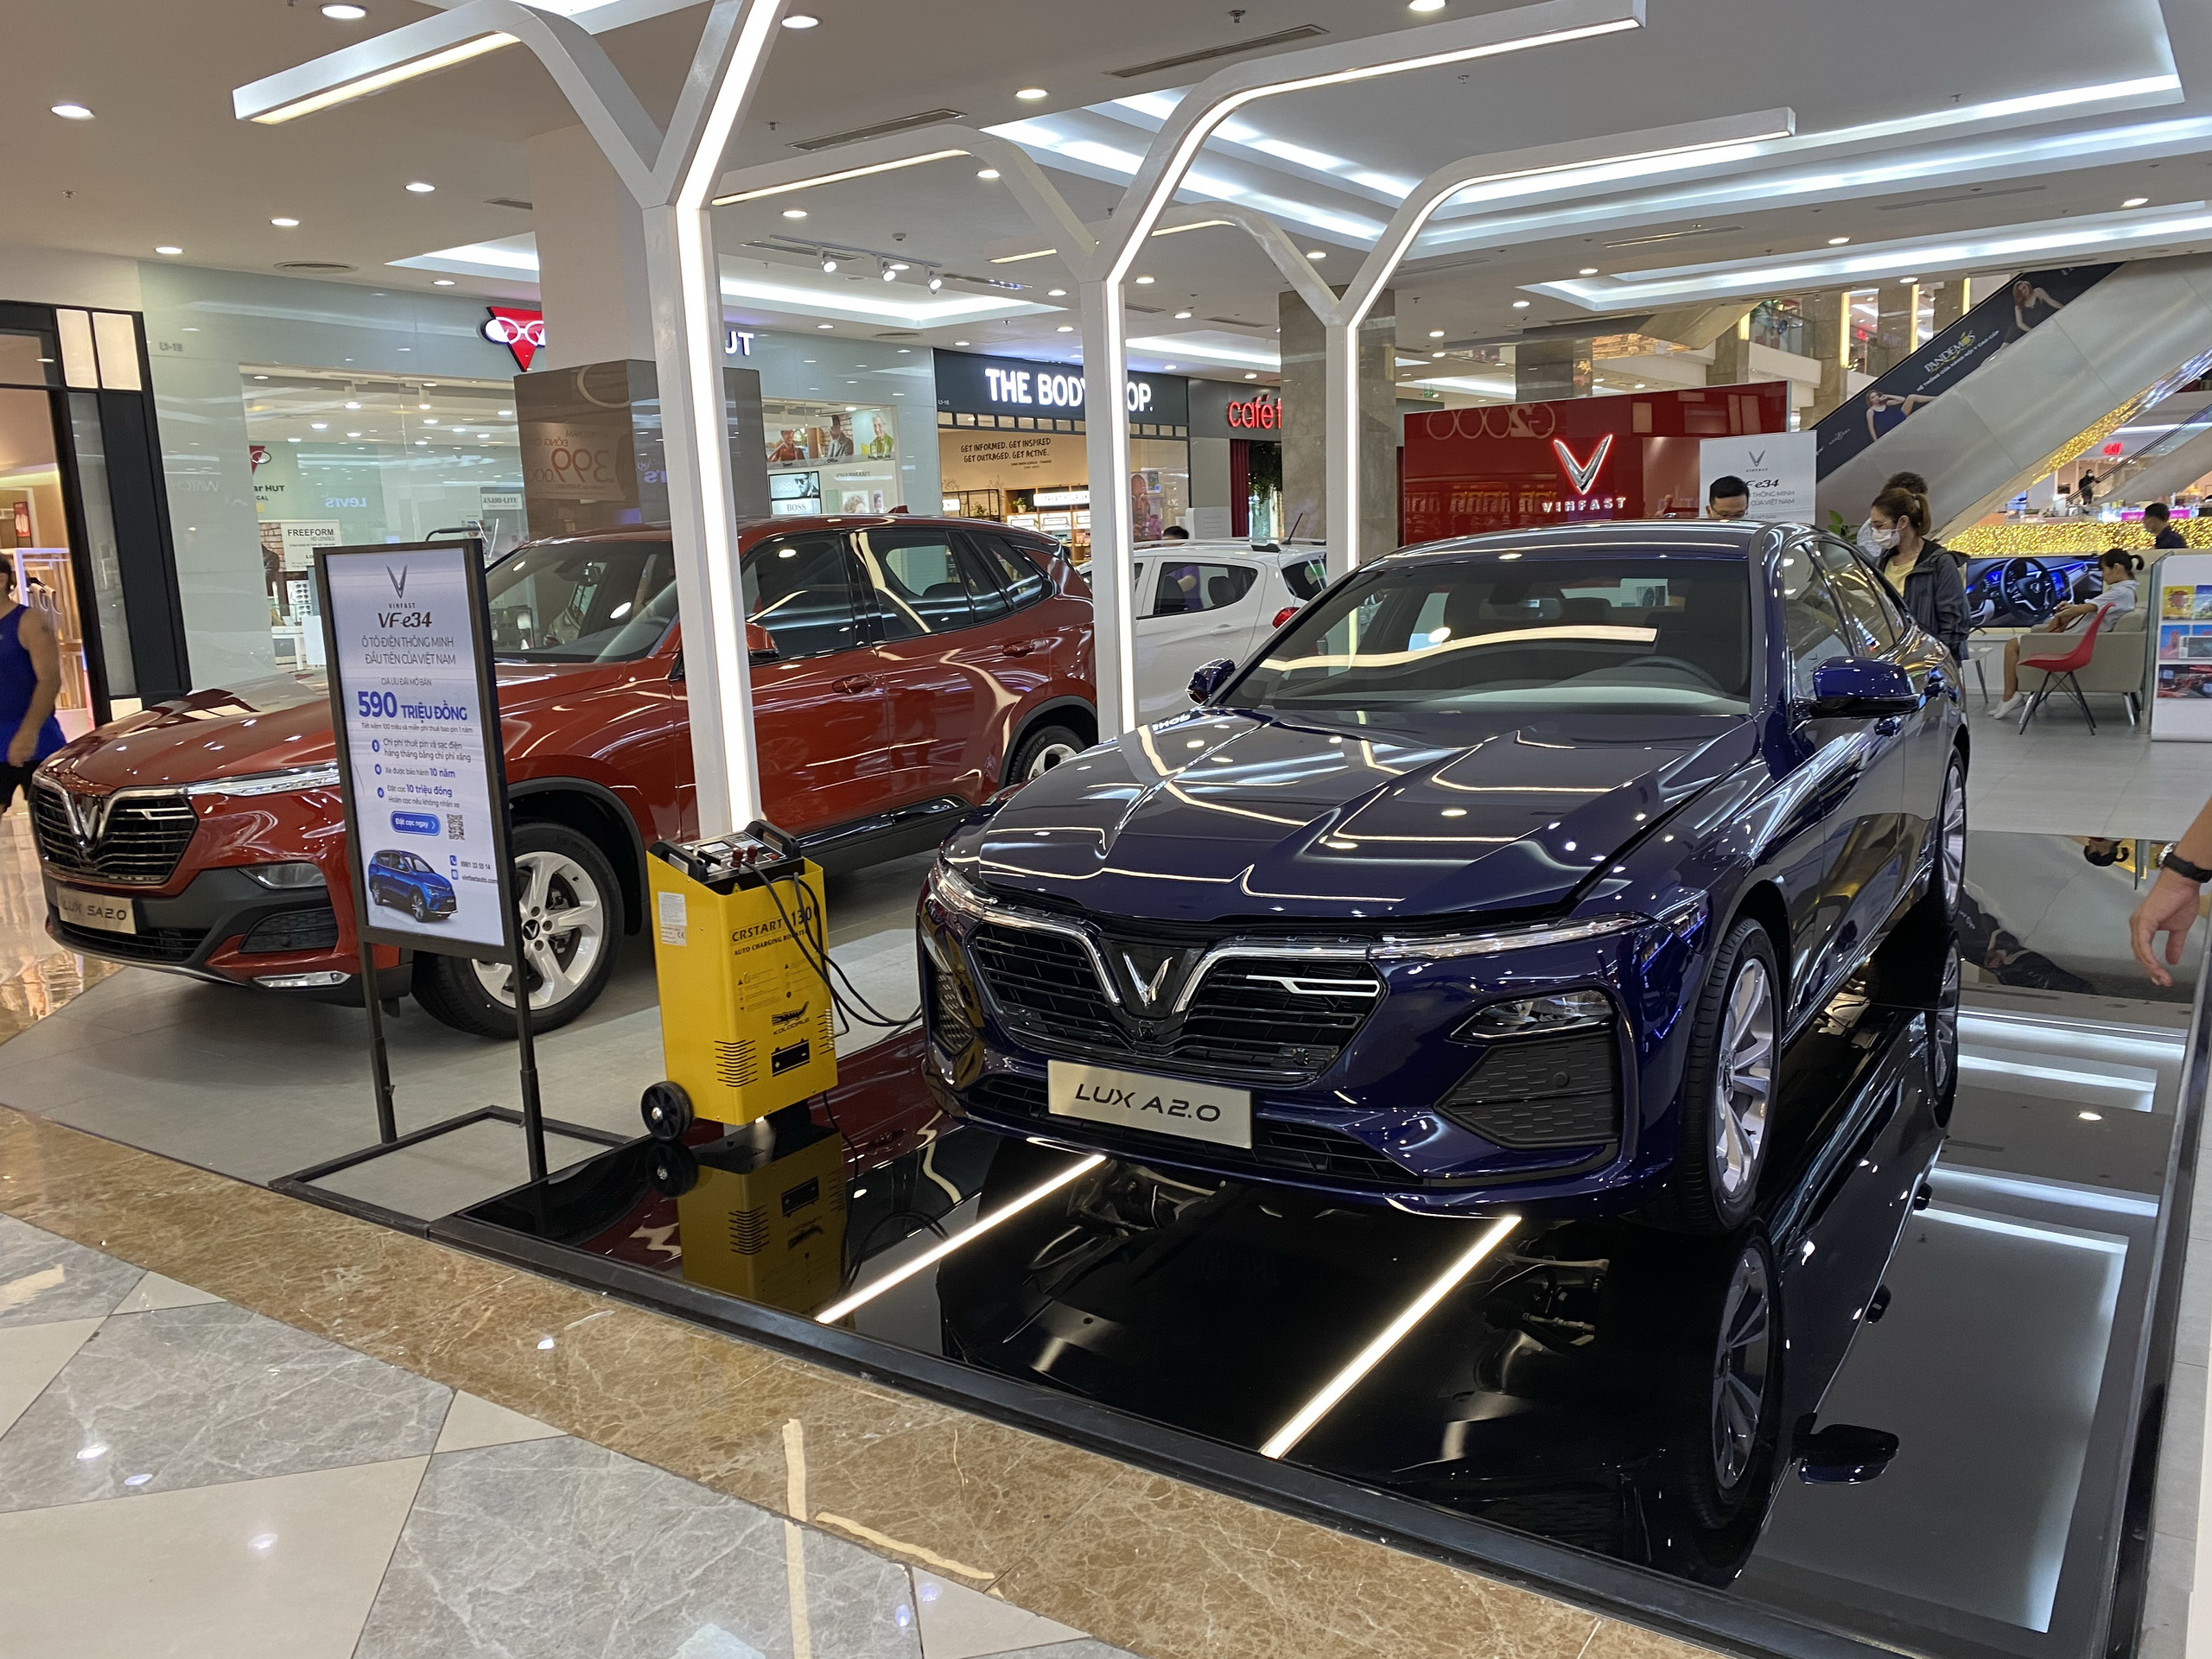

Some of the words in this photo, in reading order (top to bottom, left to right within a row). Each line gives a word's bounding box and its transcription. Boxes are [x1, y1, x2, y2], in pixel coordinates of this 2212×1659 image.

[724, 331, 754, 356] UT
[984, 368, 1033, 404] THE
[1228, 393, 1274, 429] café
[960, 444, 973, 453] GET
[974, 442, 1007, 452] INFORMED.
[1008, 440, 1021, 448] GET
[1022, 437, 1052, 448] INSPIRED
[963, 454, 976, 463] GET
[976, 452, 1011, 462] OUTRAGED.
[1012, 450, 1025, 459] GET
[1026, 448, 1050, 458] ACTIVE.
[786, 503, 806, 512] BOSS
[1541, 497, 1626, 513] VINFAST
[432, 637, 454, 647] MINH
[436, 654, 456, 664] NAM
[358, 691, 397, 718] 590
[400, 702, 433, 723] TRIỆU
[434, 700, 467, 721] ĐỒNG
[429, 767, 438, 777] 10
[406, 785, 414, 793] 10
[86, 905, 127, 921] SA2.0
[732, 918, 782, 942] CRSTART
[734, 946, 750, 956] AUTO
[752, 937, 782, 950] CHARGING
[1075, 1084, 1136, 1109] LUX
[1141, 1096, 1221, 1122] A2.0
